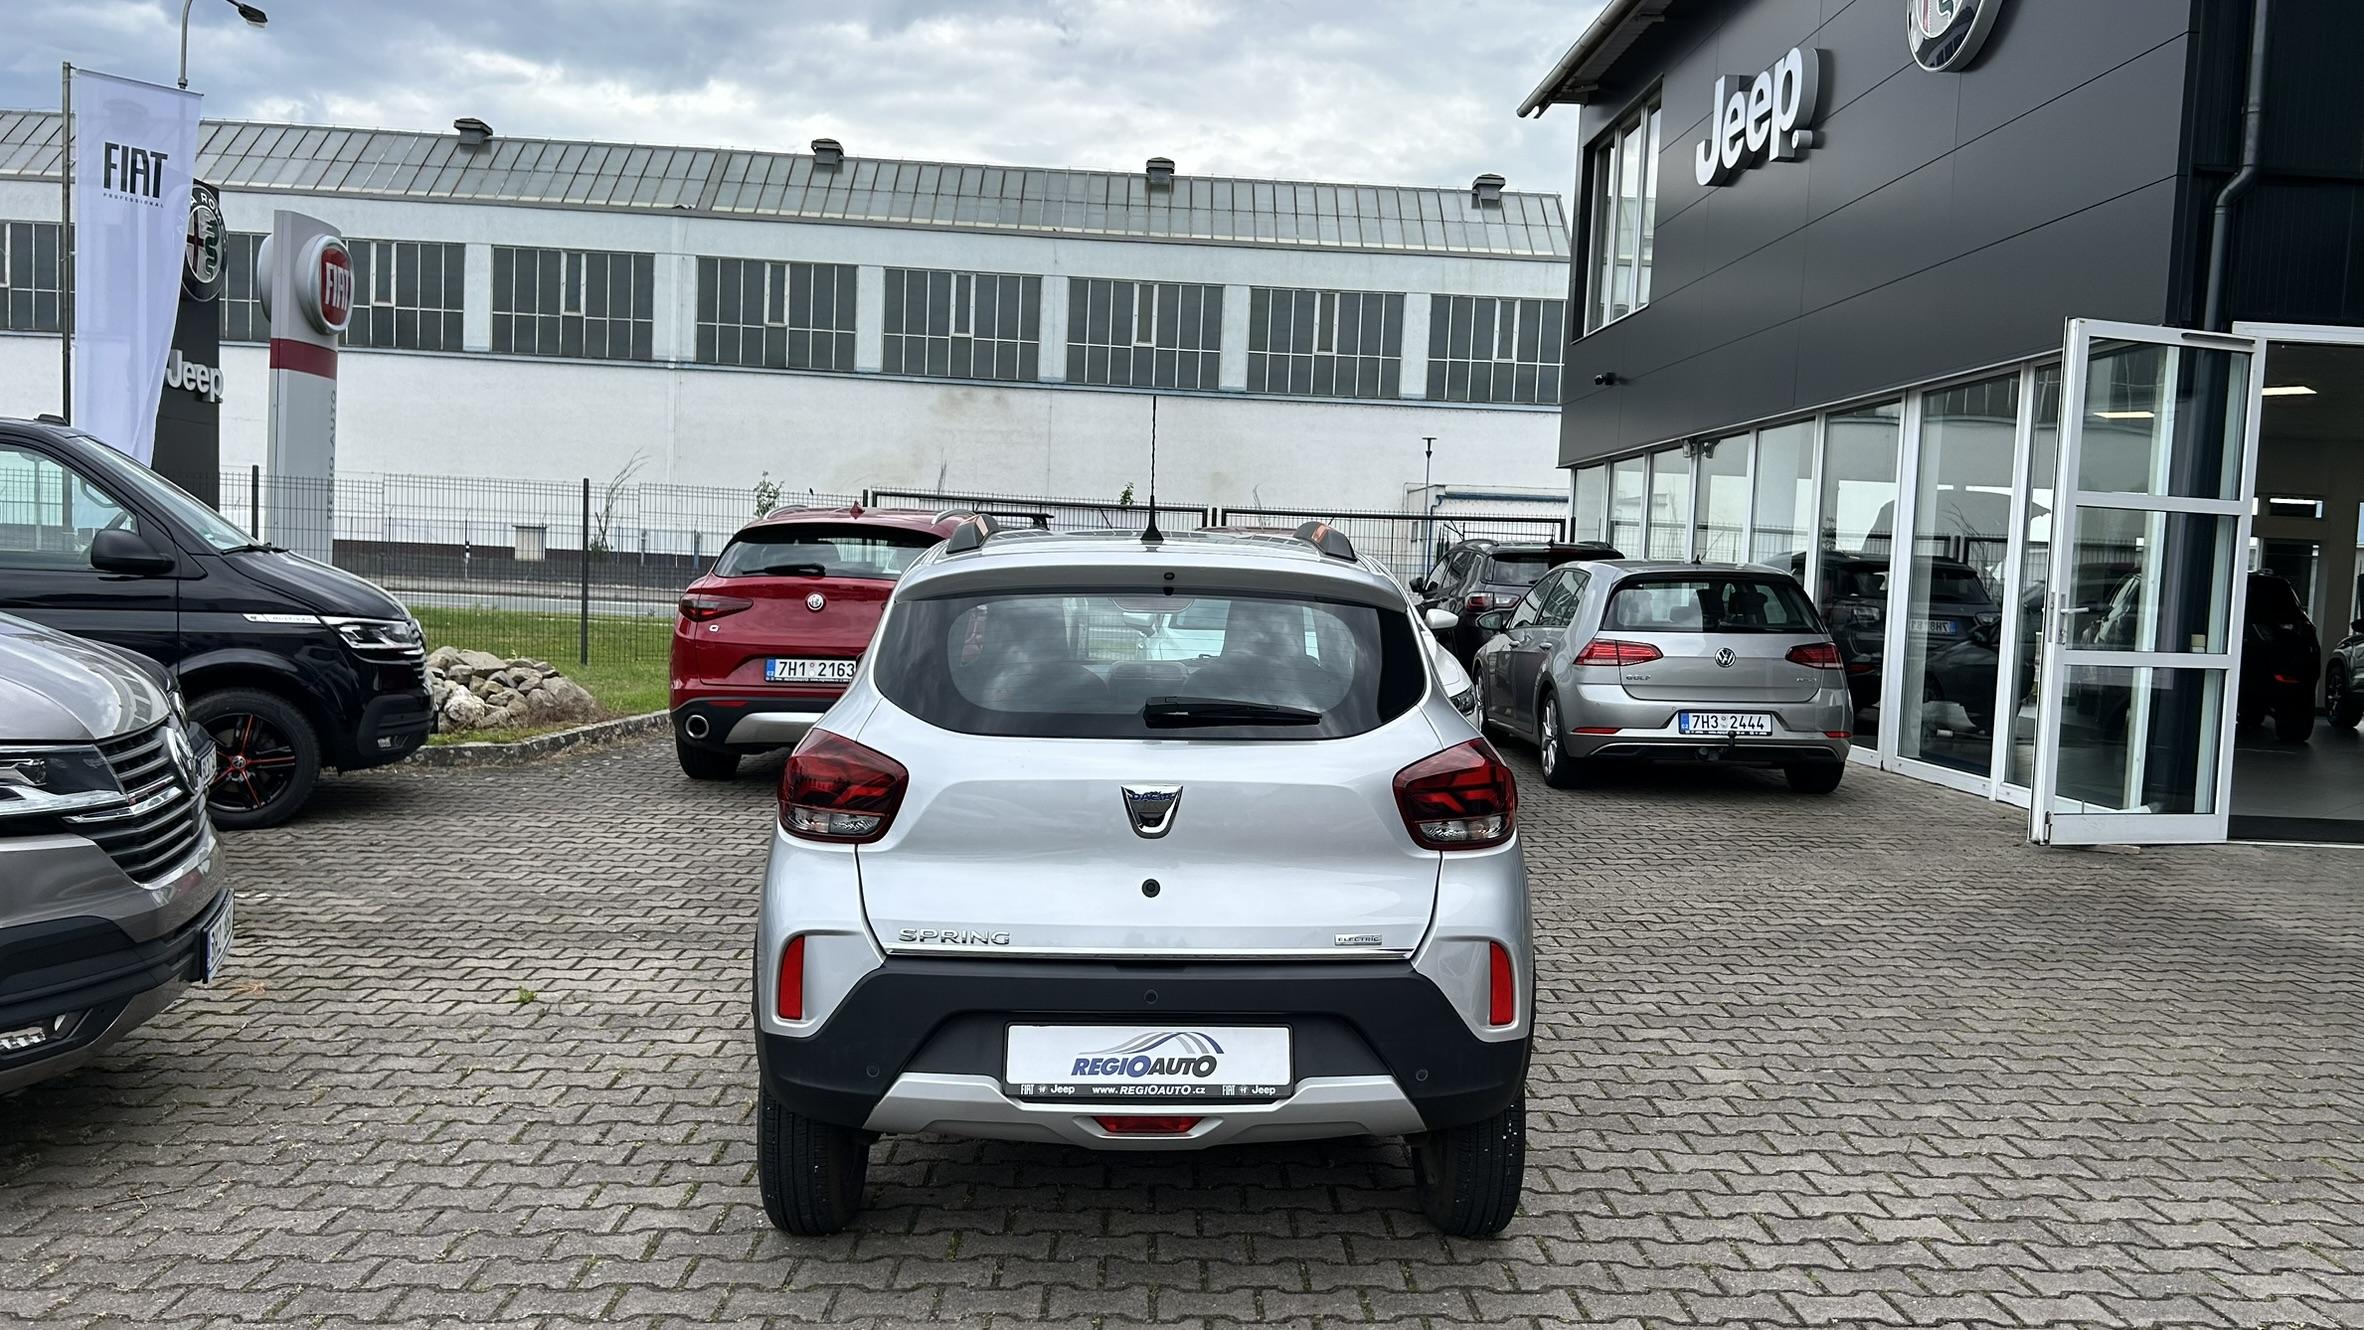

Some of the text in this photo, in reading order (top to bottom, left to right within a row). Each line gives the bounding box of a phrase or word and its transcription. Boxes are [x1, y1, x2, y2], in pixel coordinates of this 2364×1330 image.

[103, 141, 168, 199] FIAT
[103, 192, 164, 208] PROFESSIONAL
[325, 261, 350, 311] FIAT
[329, 389, 337, 448] AUTO
[779, 661, 855, 677] 7H1 2163
[1692, 715, 1764, 730] 7H3 2444
[898, 928, 1010, 945] SPRING
[1071, 1055, 1217, 1078] REGIOAUTO
[1020, 1084, 1034, 1095] FIAT
[1050, 1084, 1075, 1095] Jeep
[1222, 1085, 1235, 1096] FIAT
[1251, 1085, 1276, 1096] Jeep
